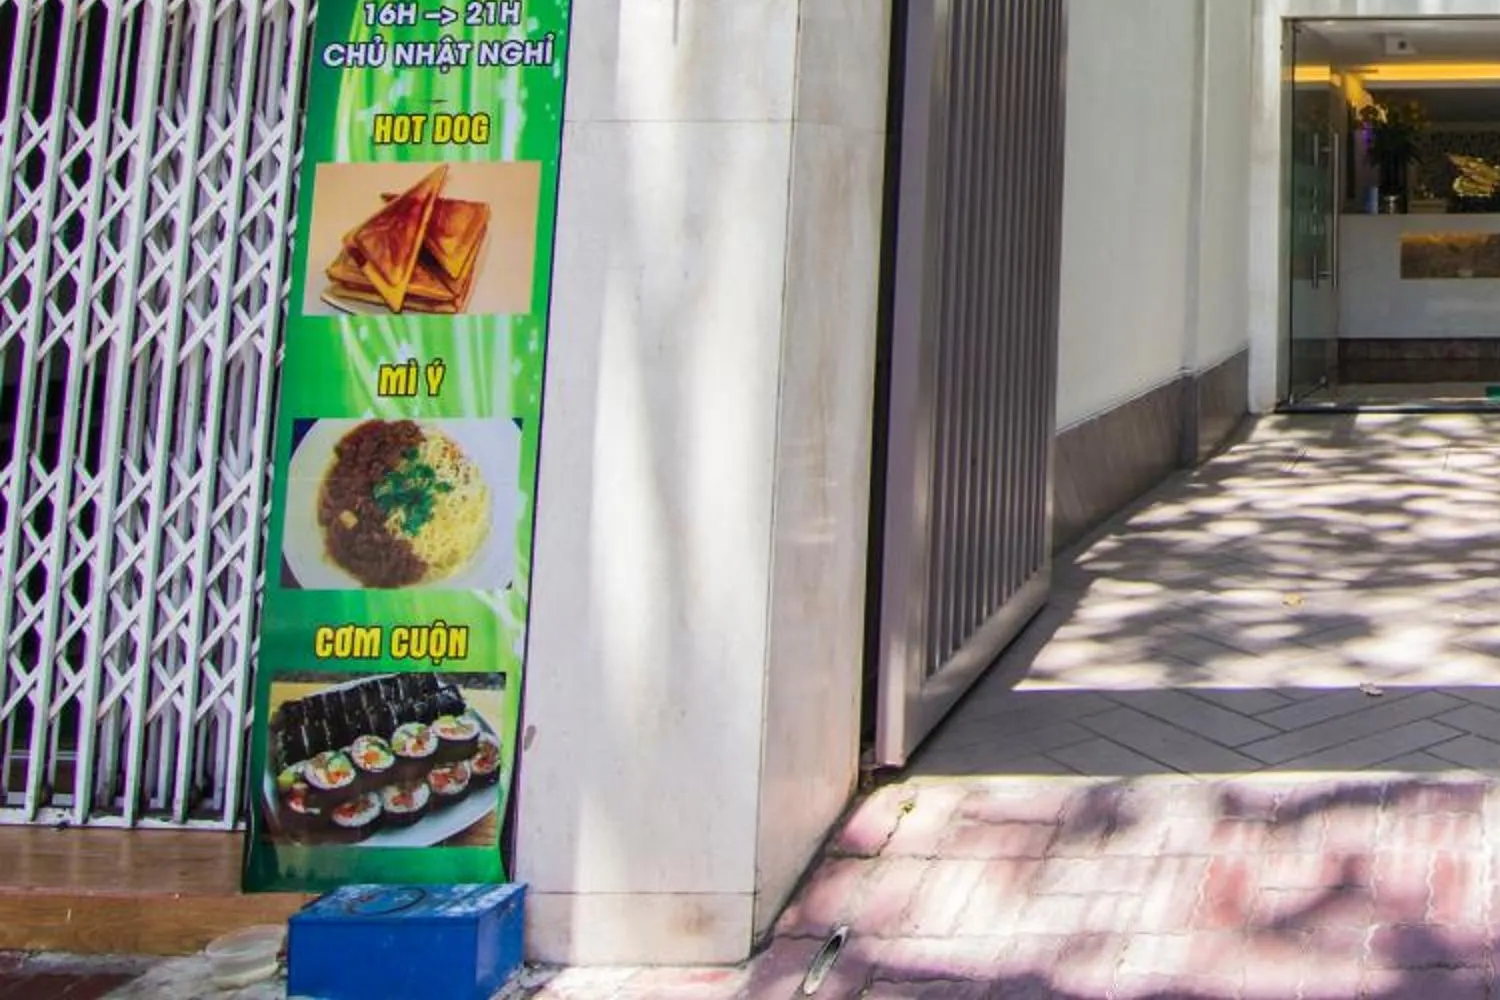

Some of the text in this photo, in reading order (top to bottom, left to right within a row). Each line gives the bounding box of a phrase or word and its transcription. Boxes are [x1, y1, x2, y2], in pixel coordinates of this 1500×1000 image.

[364, 0, 521, 26] 16H 21H
[323, 34, 555, 73] CHỦ NHẬT NGHỈ
[373, 114, 490, 144] HOT DOG
[425, 357, 446, 396] Ý
[315, 619, 468, 665] CƠM CUỘN
